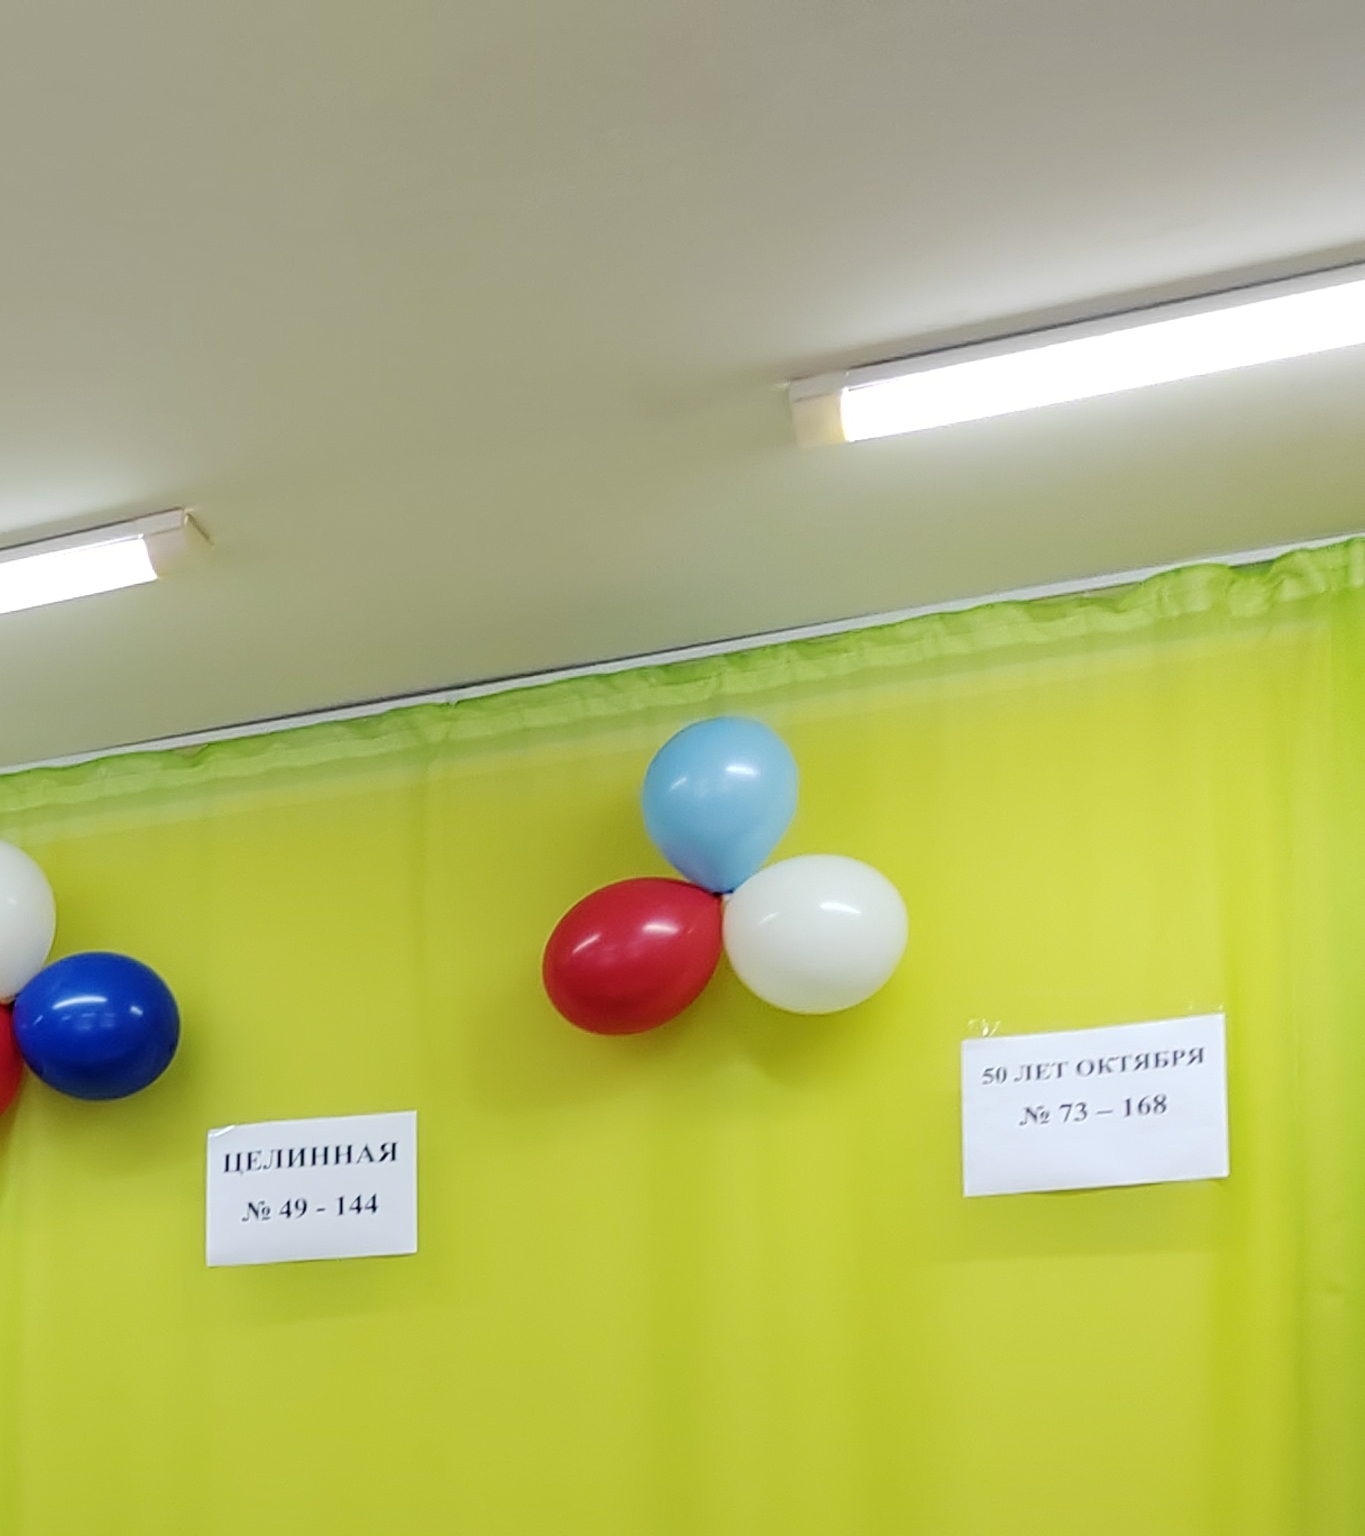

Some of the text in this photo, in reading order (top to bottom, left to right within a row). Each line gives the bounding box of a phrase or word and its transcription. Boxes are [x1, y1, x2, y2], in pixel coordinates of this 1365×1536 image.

[981, 1046, 1205, 1086] 50 ЛЕТ ОКТЯБРЯ
[1017, 1104, 1051, 1127] №
[1058, 1100, 1089, 1124] 73
[1124, 1093, 1168, 1118] 168
[223, 1141, 398, 1176] ЦЕЛИННАЯ
[240, 1199, 272, 1223] №
[278, 1197, 309, 1220] 49
[337, 1193, 379, 1218] 144
